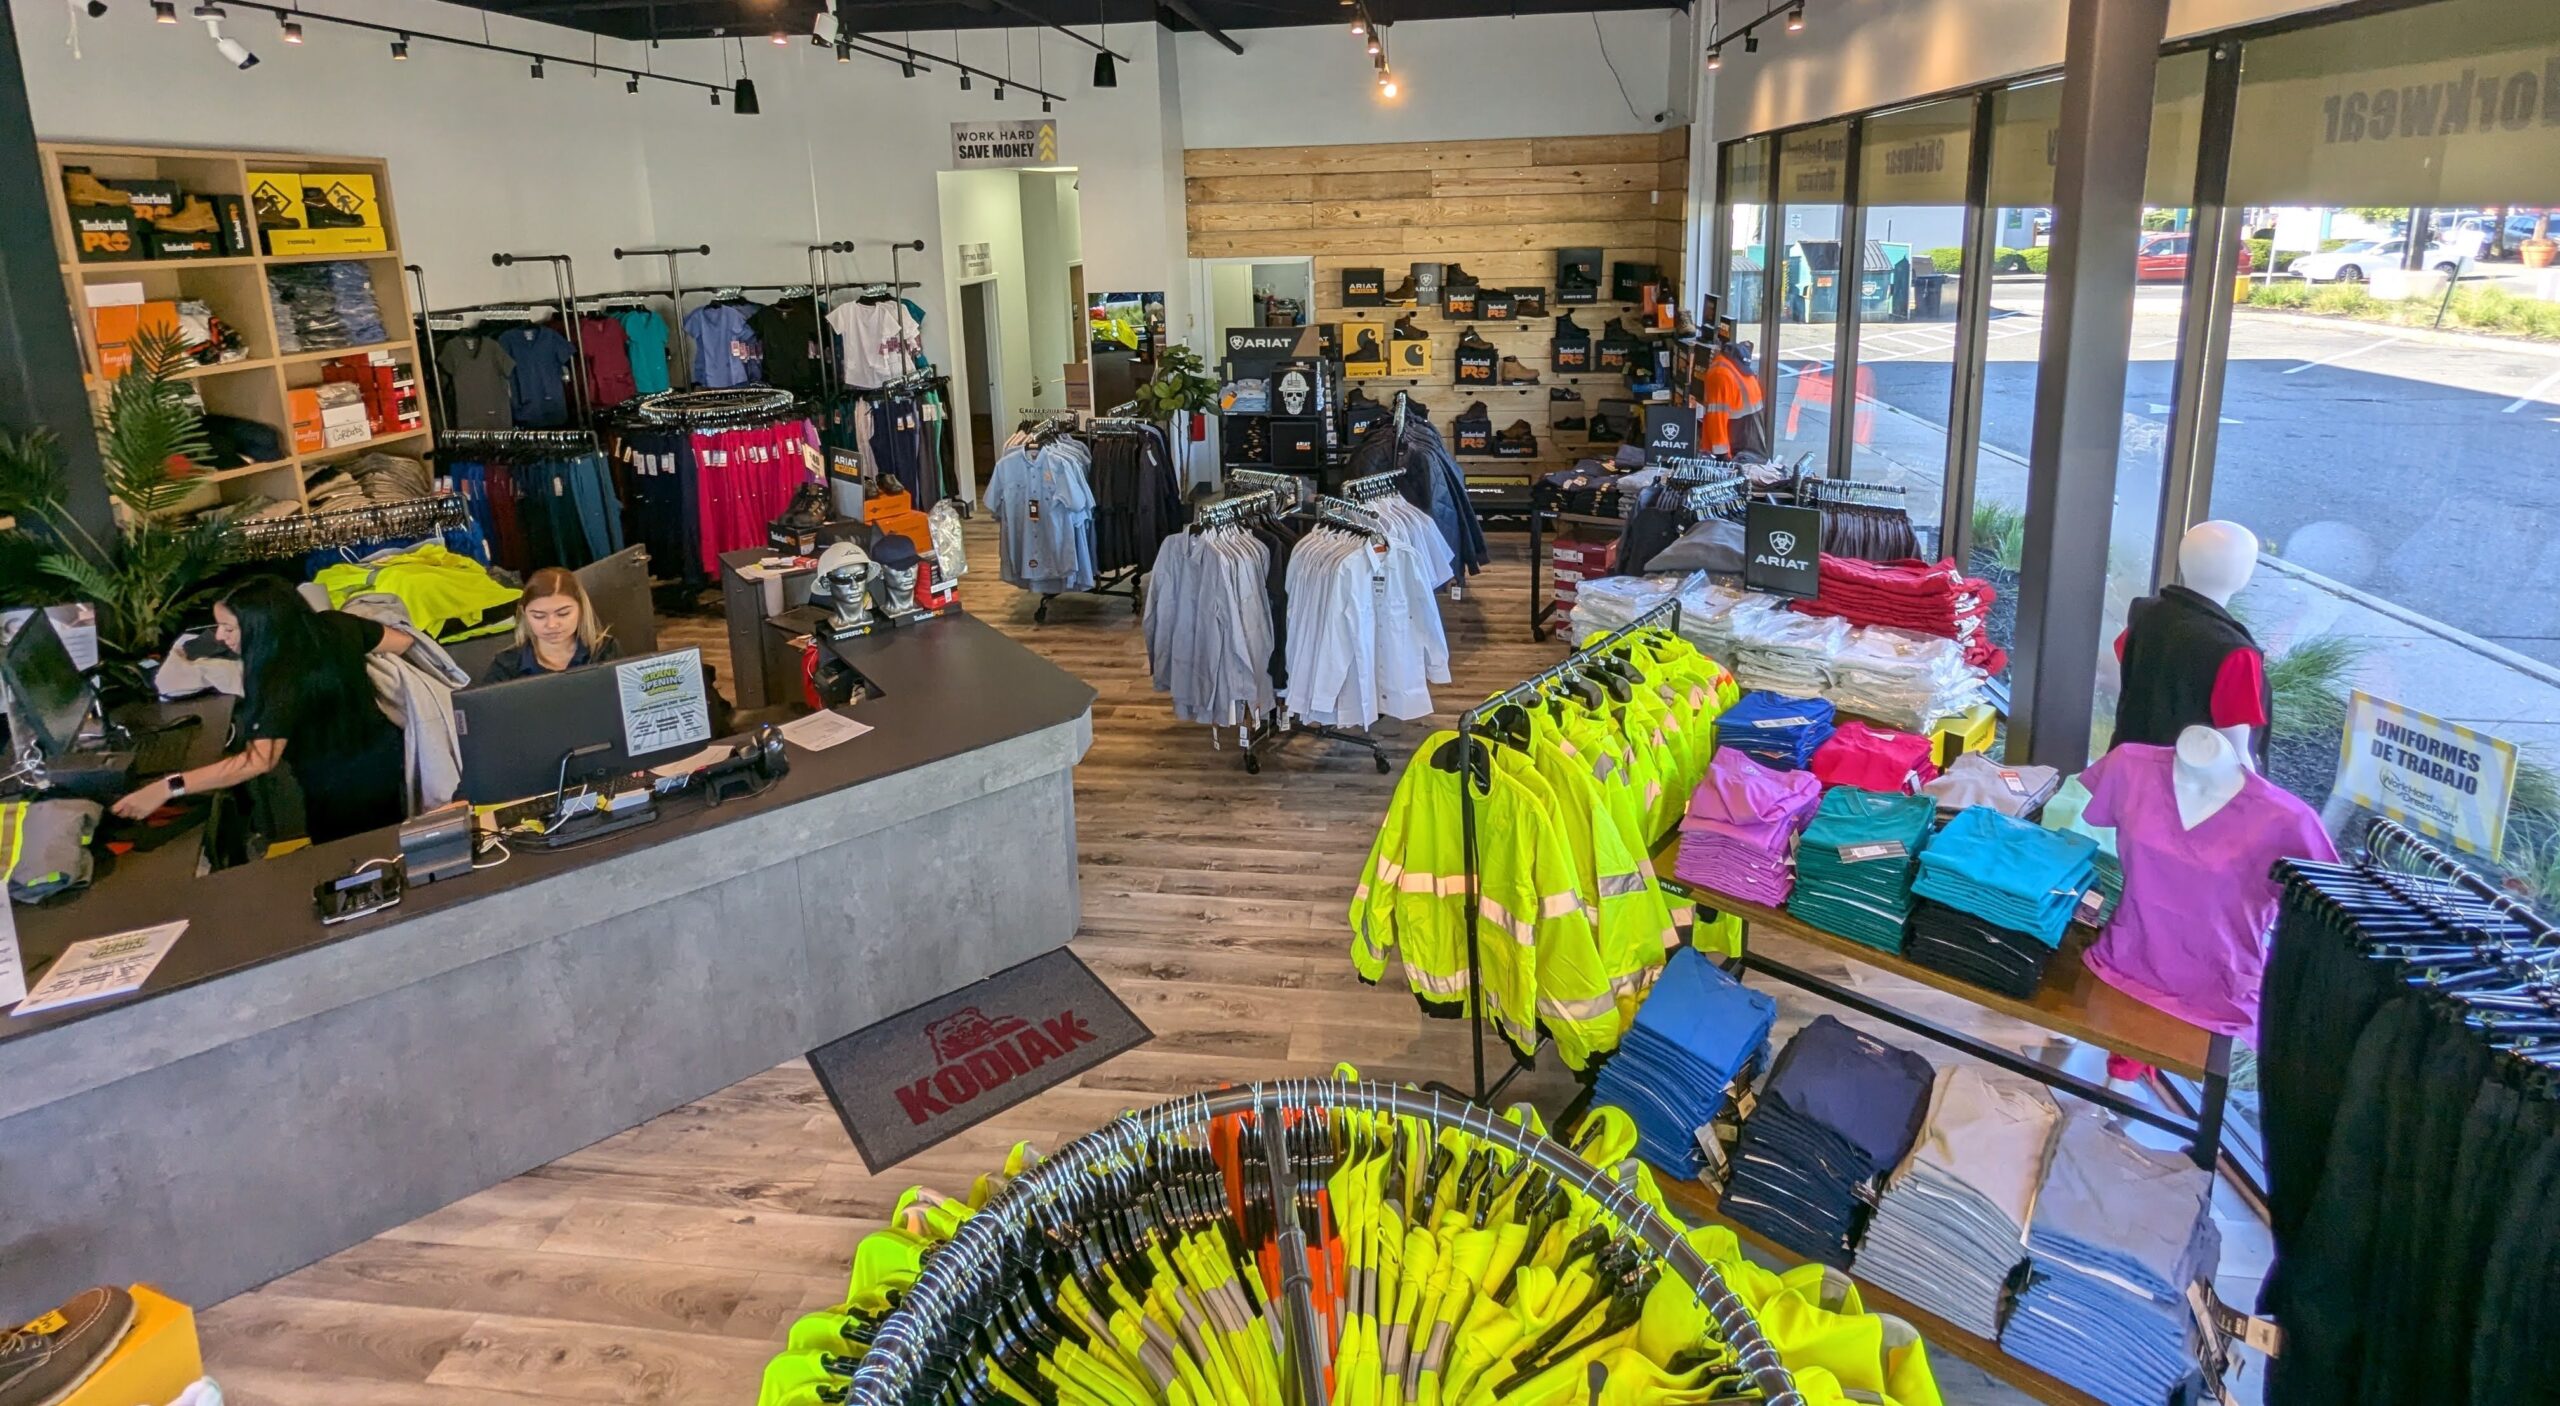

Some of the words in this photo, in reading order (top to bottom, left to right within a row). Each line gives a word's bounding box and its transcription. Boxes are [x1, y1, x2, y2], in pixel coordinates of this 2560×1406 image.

[957, 131, 995, 142] WORK
[1000, 130, 1035, 141] HARD
[958, 144, 989, 159] SAVE
[993, 143, 1035, 158] MONEY
[79, 219, 128, 231] Timberland
[81, 231, 132, 253] PRO
[1449, 301, 1475, 313] PRO
[1244, 338, 1292, 348] ARIAT
[1460, 358, 1491, 366] Timberland
[1460, 365, 1491, 379] PRO
[1652, 440, 1689, 450] ARIAT
[834, 455, 858, 468] ARIAT
[1755, 554, 1809, 571] ARIAT
[833, 628, 865, 641] TERRA
[642, 668, 679, 683] GRAND
[639, 676, 686, 692] OPENING
[2375, 718, 2482, 773] UNIFORMES
[2371, 739, 2393, 762] DE
[2397, 749, 2479, 796] TRABAJO
[1660, 881, 1684, 894] RIAT
[894, 1010, 1098, 1126] KODIAK
